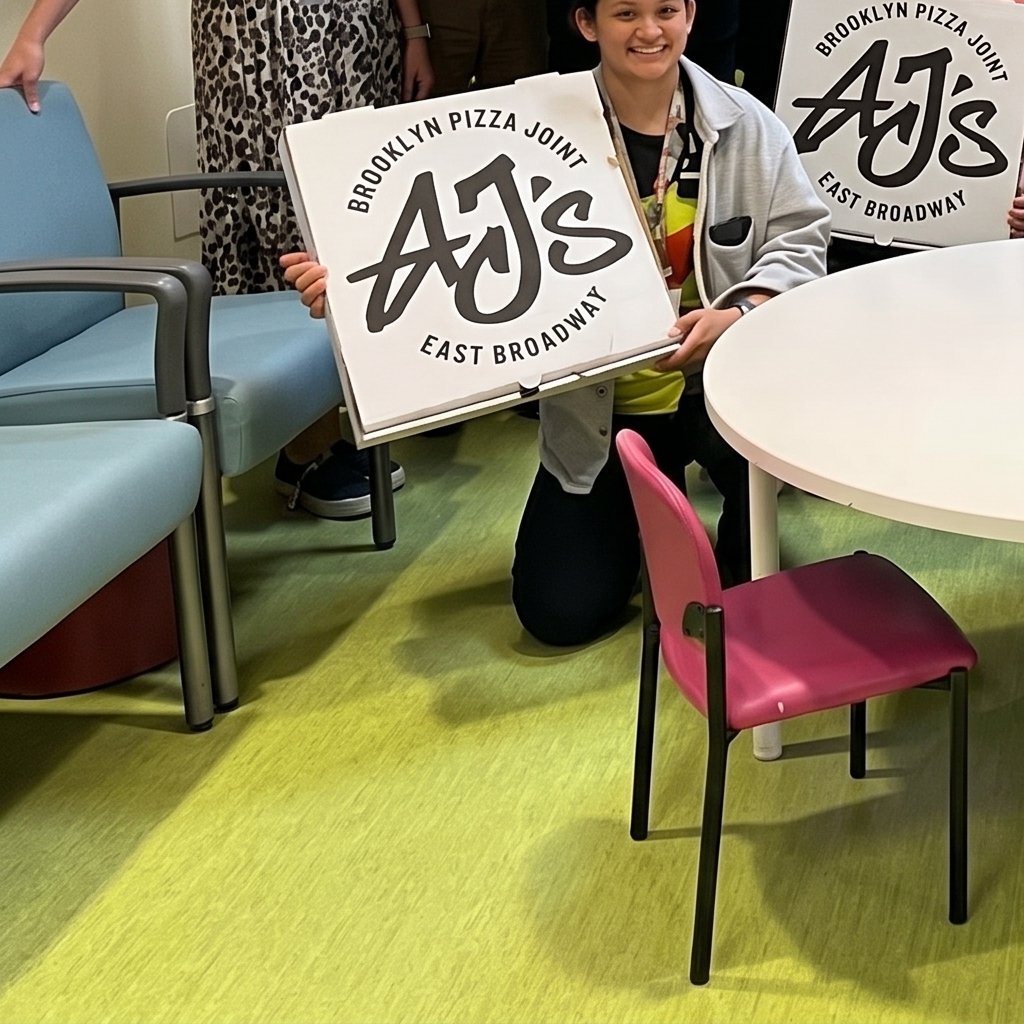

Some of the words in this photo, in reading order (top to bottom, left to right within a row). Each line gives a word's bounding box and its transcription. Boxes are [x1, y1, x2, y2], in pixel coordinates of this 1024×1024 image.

[815, 1, 909, 57] BROOKLYN
[915, 3, 968, 37] PIZZA
[967, 34, 1009, 82] JOINT
[347, 117, 443, 214] BROOKLYN
[448, 109, 517, 132] PIZZA
[524, 121, 588, 169] JOINT
[817, 171, 863, 209] EAST
[864, 189, 966, 223] BROADWAY
[420, 334, 485, 365] EAST
[493, 286, 608, 365] BROADWAY
